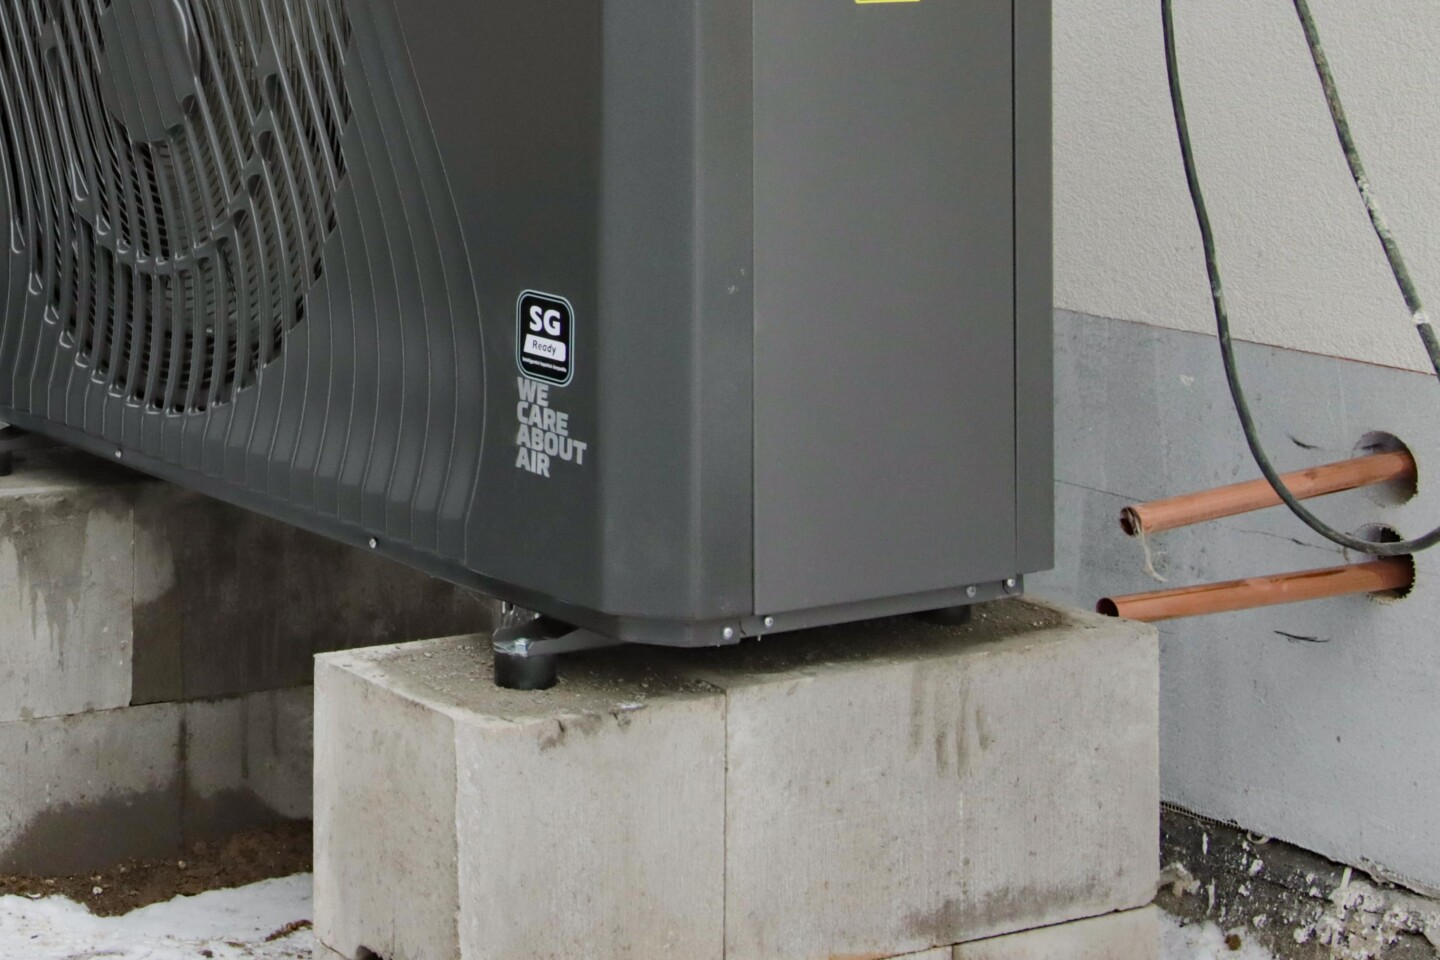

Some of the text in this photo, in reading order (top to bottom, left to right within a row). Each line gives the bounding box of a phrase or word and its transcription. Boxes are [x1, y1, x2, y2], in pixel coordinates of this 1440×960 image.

[529, 305, 561, 337] SG
[531, 339, 557, 357] Ready
[517, 376, 550, 407] WE
[516, 401, 569, 436] CARE
[516, 423, 587, 466] ABOUT
[515, 447, 551, 478] AIR
